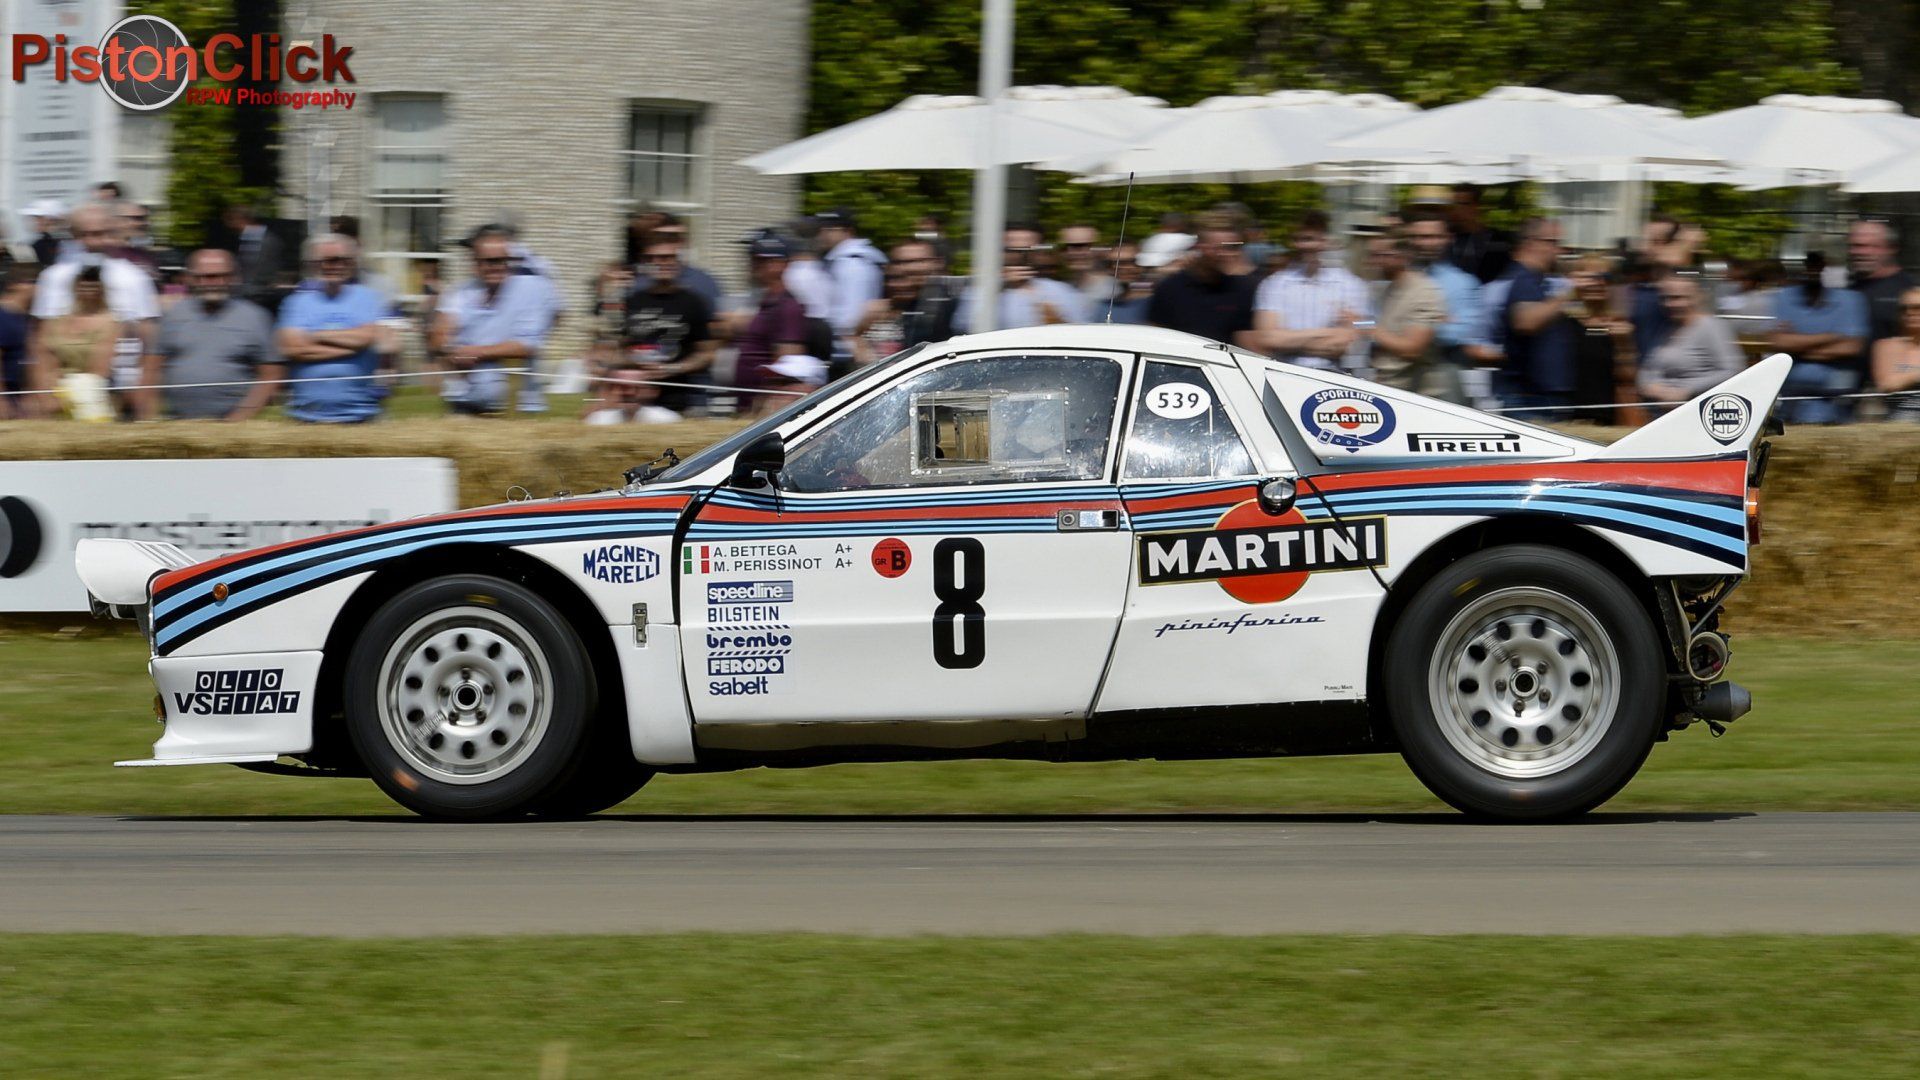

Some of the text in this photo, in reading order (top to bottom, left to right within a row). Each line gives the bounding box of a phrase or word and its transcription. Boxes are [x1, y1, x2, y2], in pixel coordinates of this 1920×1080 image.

[1158, 392, 1199, 409] 539
[1315, 389, 1376, 403] SPORTLINE
[1319, 412, 1377, 423] MARTINI
[1713, 412, 1739, 421] LANCIA
[1407, 433, 1521, 453] PIRELLI
[583, 545, 660, 572] MAGNETI
[713, 543, 853, 558] A. BETTEGA A+
[891, 549, 907, 571] B
[1148, 525, 1377, 577] MARTINI
[583, 556, 660, 583] MARELLI
[713, 558, 853, 572] M. PERISSINOT A+
[708, 583, 783, 603] speedline
[933, 537, 986, 669] 8
[707, 606, 779, 622] BILSTEIN
[1155, 613, 1326, 637] pininfarina
[706, 632, 792, 648] brembo
[710, 658, 781, 673] FERODO
[198, 671, 280, 690] OLIO
[709, 676, 768, 695] sabelt
